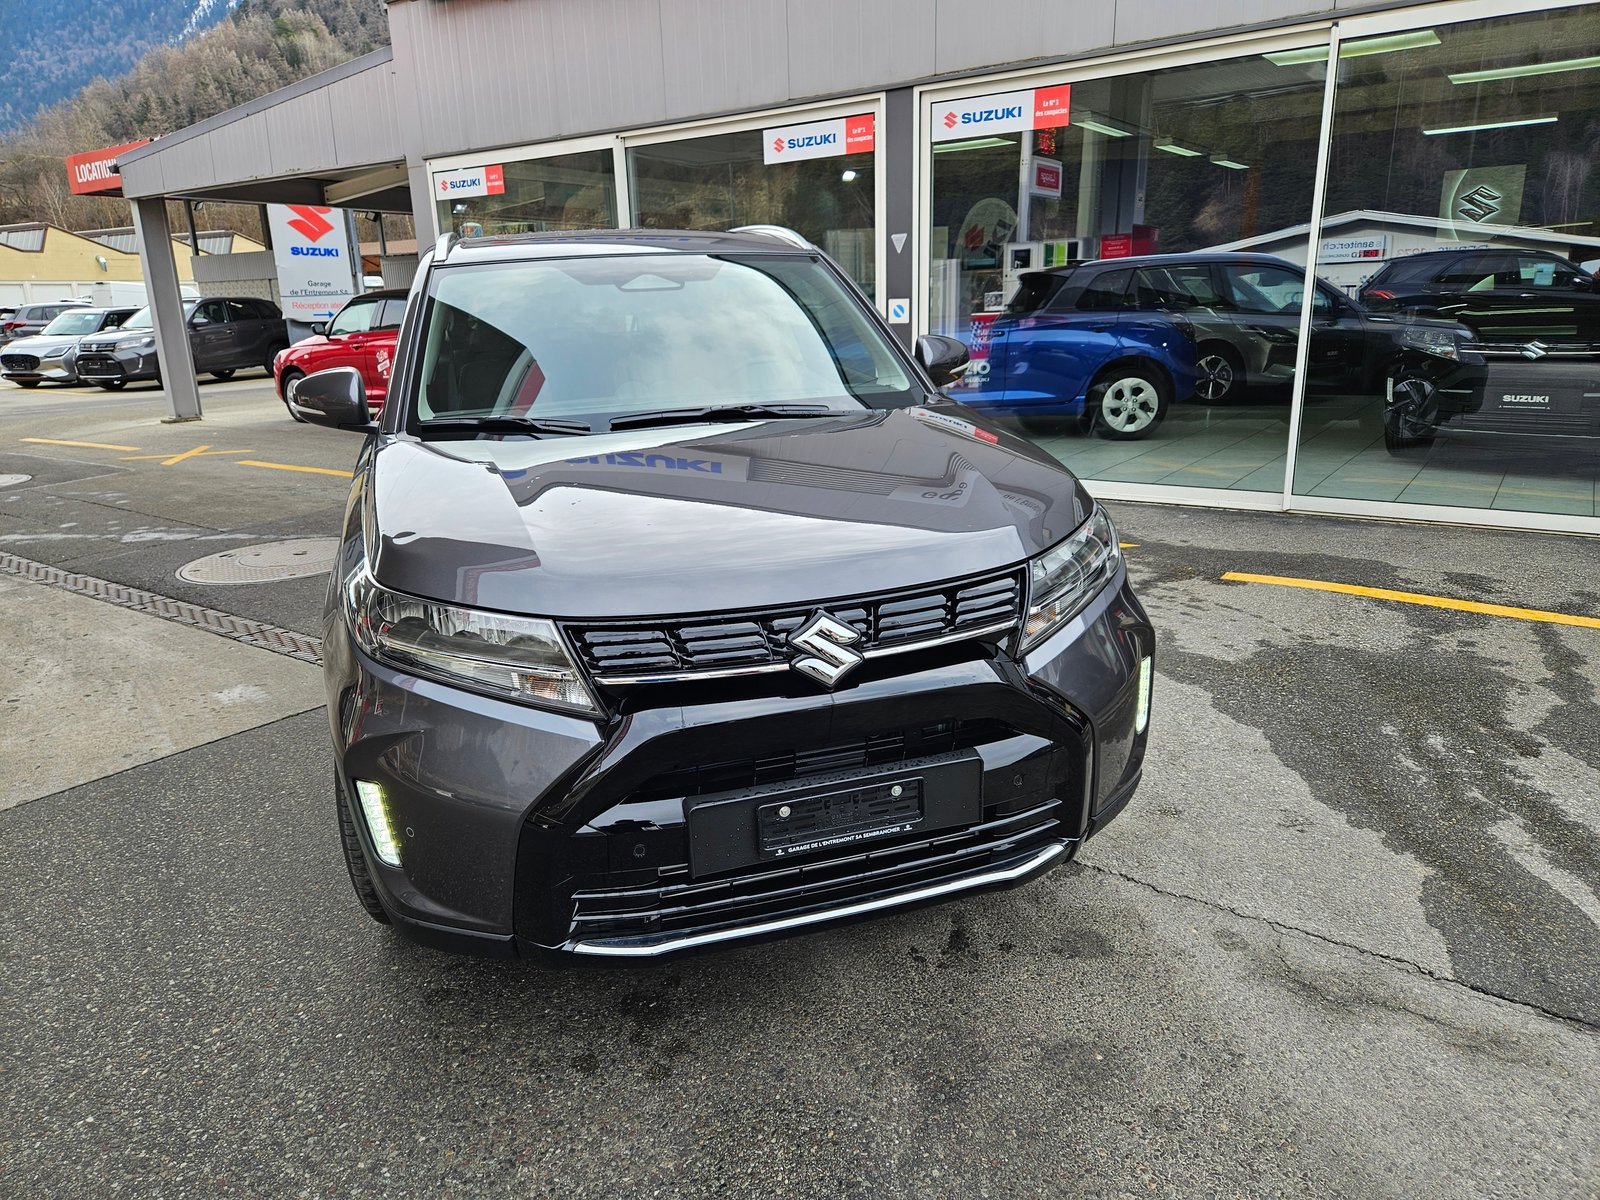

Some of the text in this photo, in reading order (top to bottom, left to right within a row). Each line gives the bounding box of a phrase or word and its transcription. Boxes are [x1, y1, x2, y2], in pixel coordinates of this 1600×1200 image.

[961, 106, 1022, 124] SUZUKI
[788, 133, 836, 149] SUZUKI
[450, 178, 481, 189] SUZUKI
[290, 246, 339, 257] SUZUKI
[1502, 394, 1550, 403] SUZUKI
[787, 843, 811, 853] GARAGE
[818, 835, 856, 847] L'ENTREMONT
[863, 826, 901, 838] SEMBRANCHER
